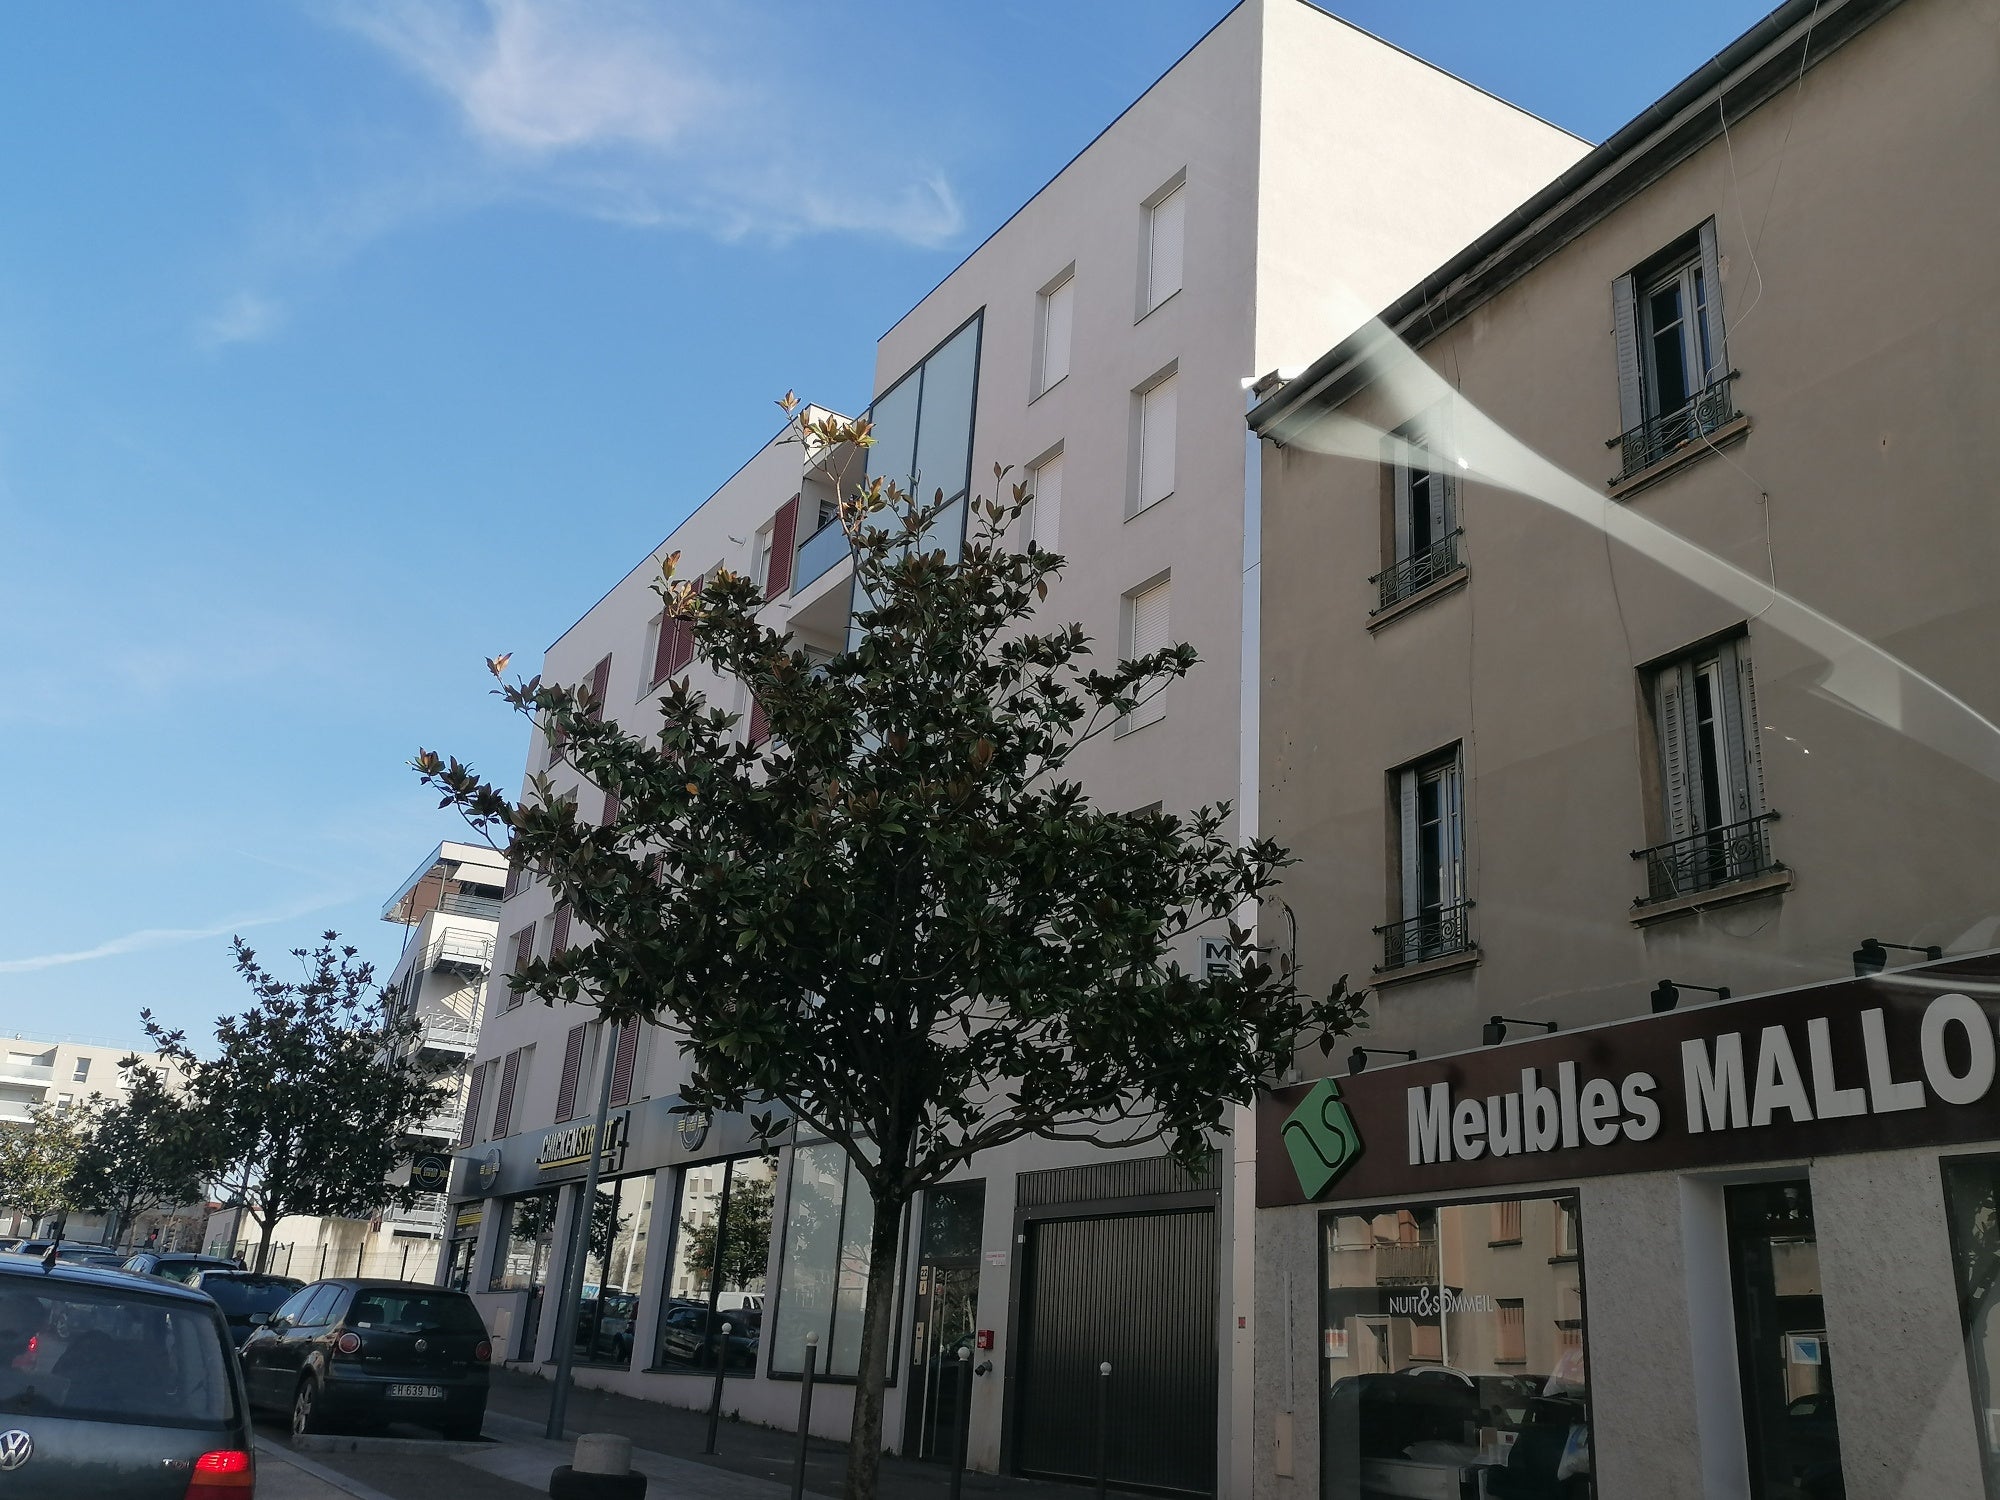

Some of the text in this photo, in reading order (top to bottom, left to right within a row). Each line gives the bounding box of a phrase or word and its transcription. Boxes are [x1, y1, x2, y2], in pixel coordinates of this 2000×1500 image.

[1408, 993, 2000, 1165] Meubles MALLO
[406, 1385, 423, 1396] 639
